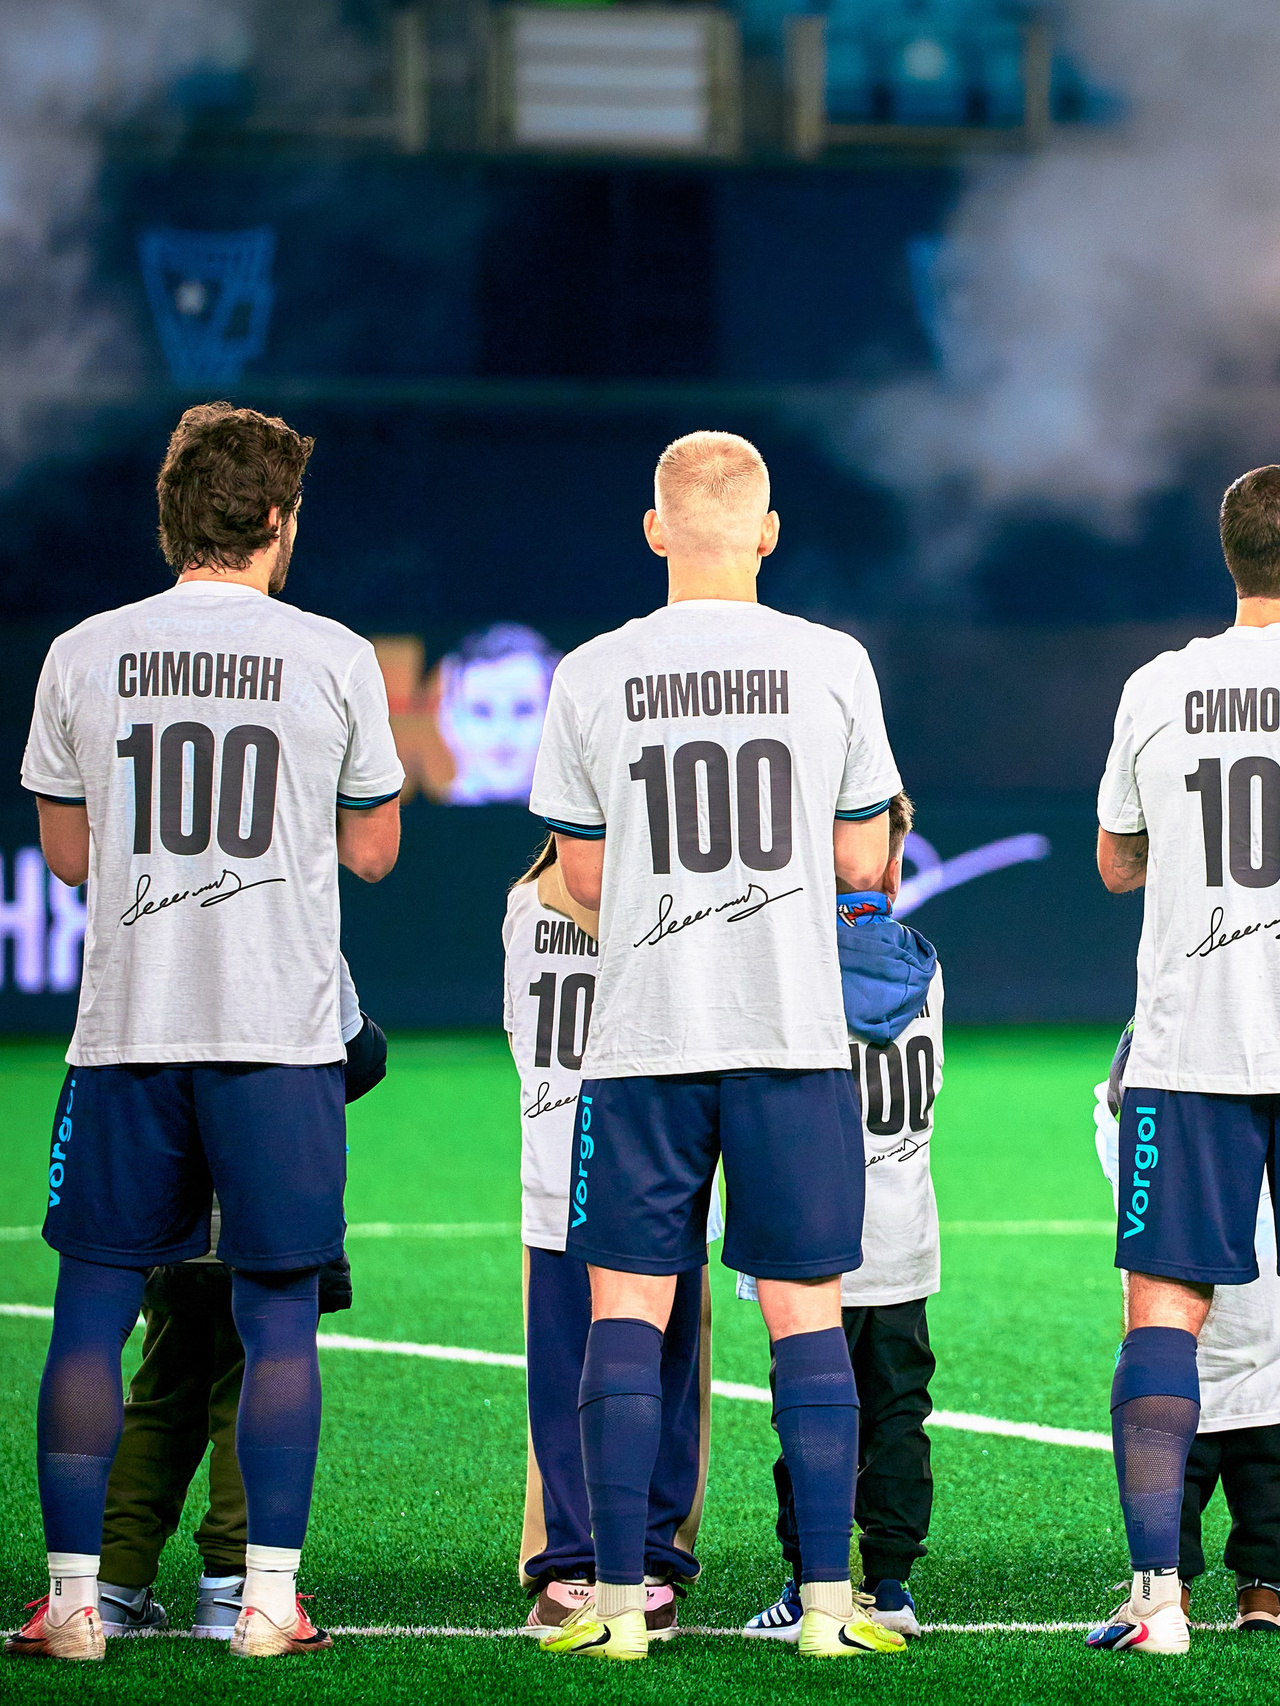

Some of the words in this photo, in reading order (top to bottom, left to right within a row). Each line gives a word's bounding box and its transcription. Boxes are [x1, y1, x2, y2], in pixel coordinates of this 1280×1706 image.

[117, 651, 284, 702] СИМОНЯН
[624, 669, 789, 722] СИМОНЯН
[116, 721, 280, 859] 100
[628, 738, 793, 875] 100
[529, 971, 597, 1070] 10
[571, 1095, 595, 1228] Vorgol
[1123, 1106, 1159, 1239] Vorgol
[1142, 1571, 1151, 1600] ESIGN
